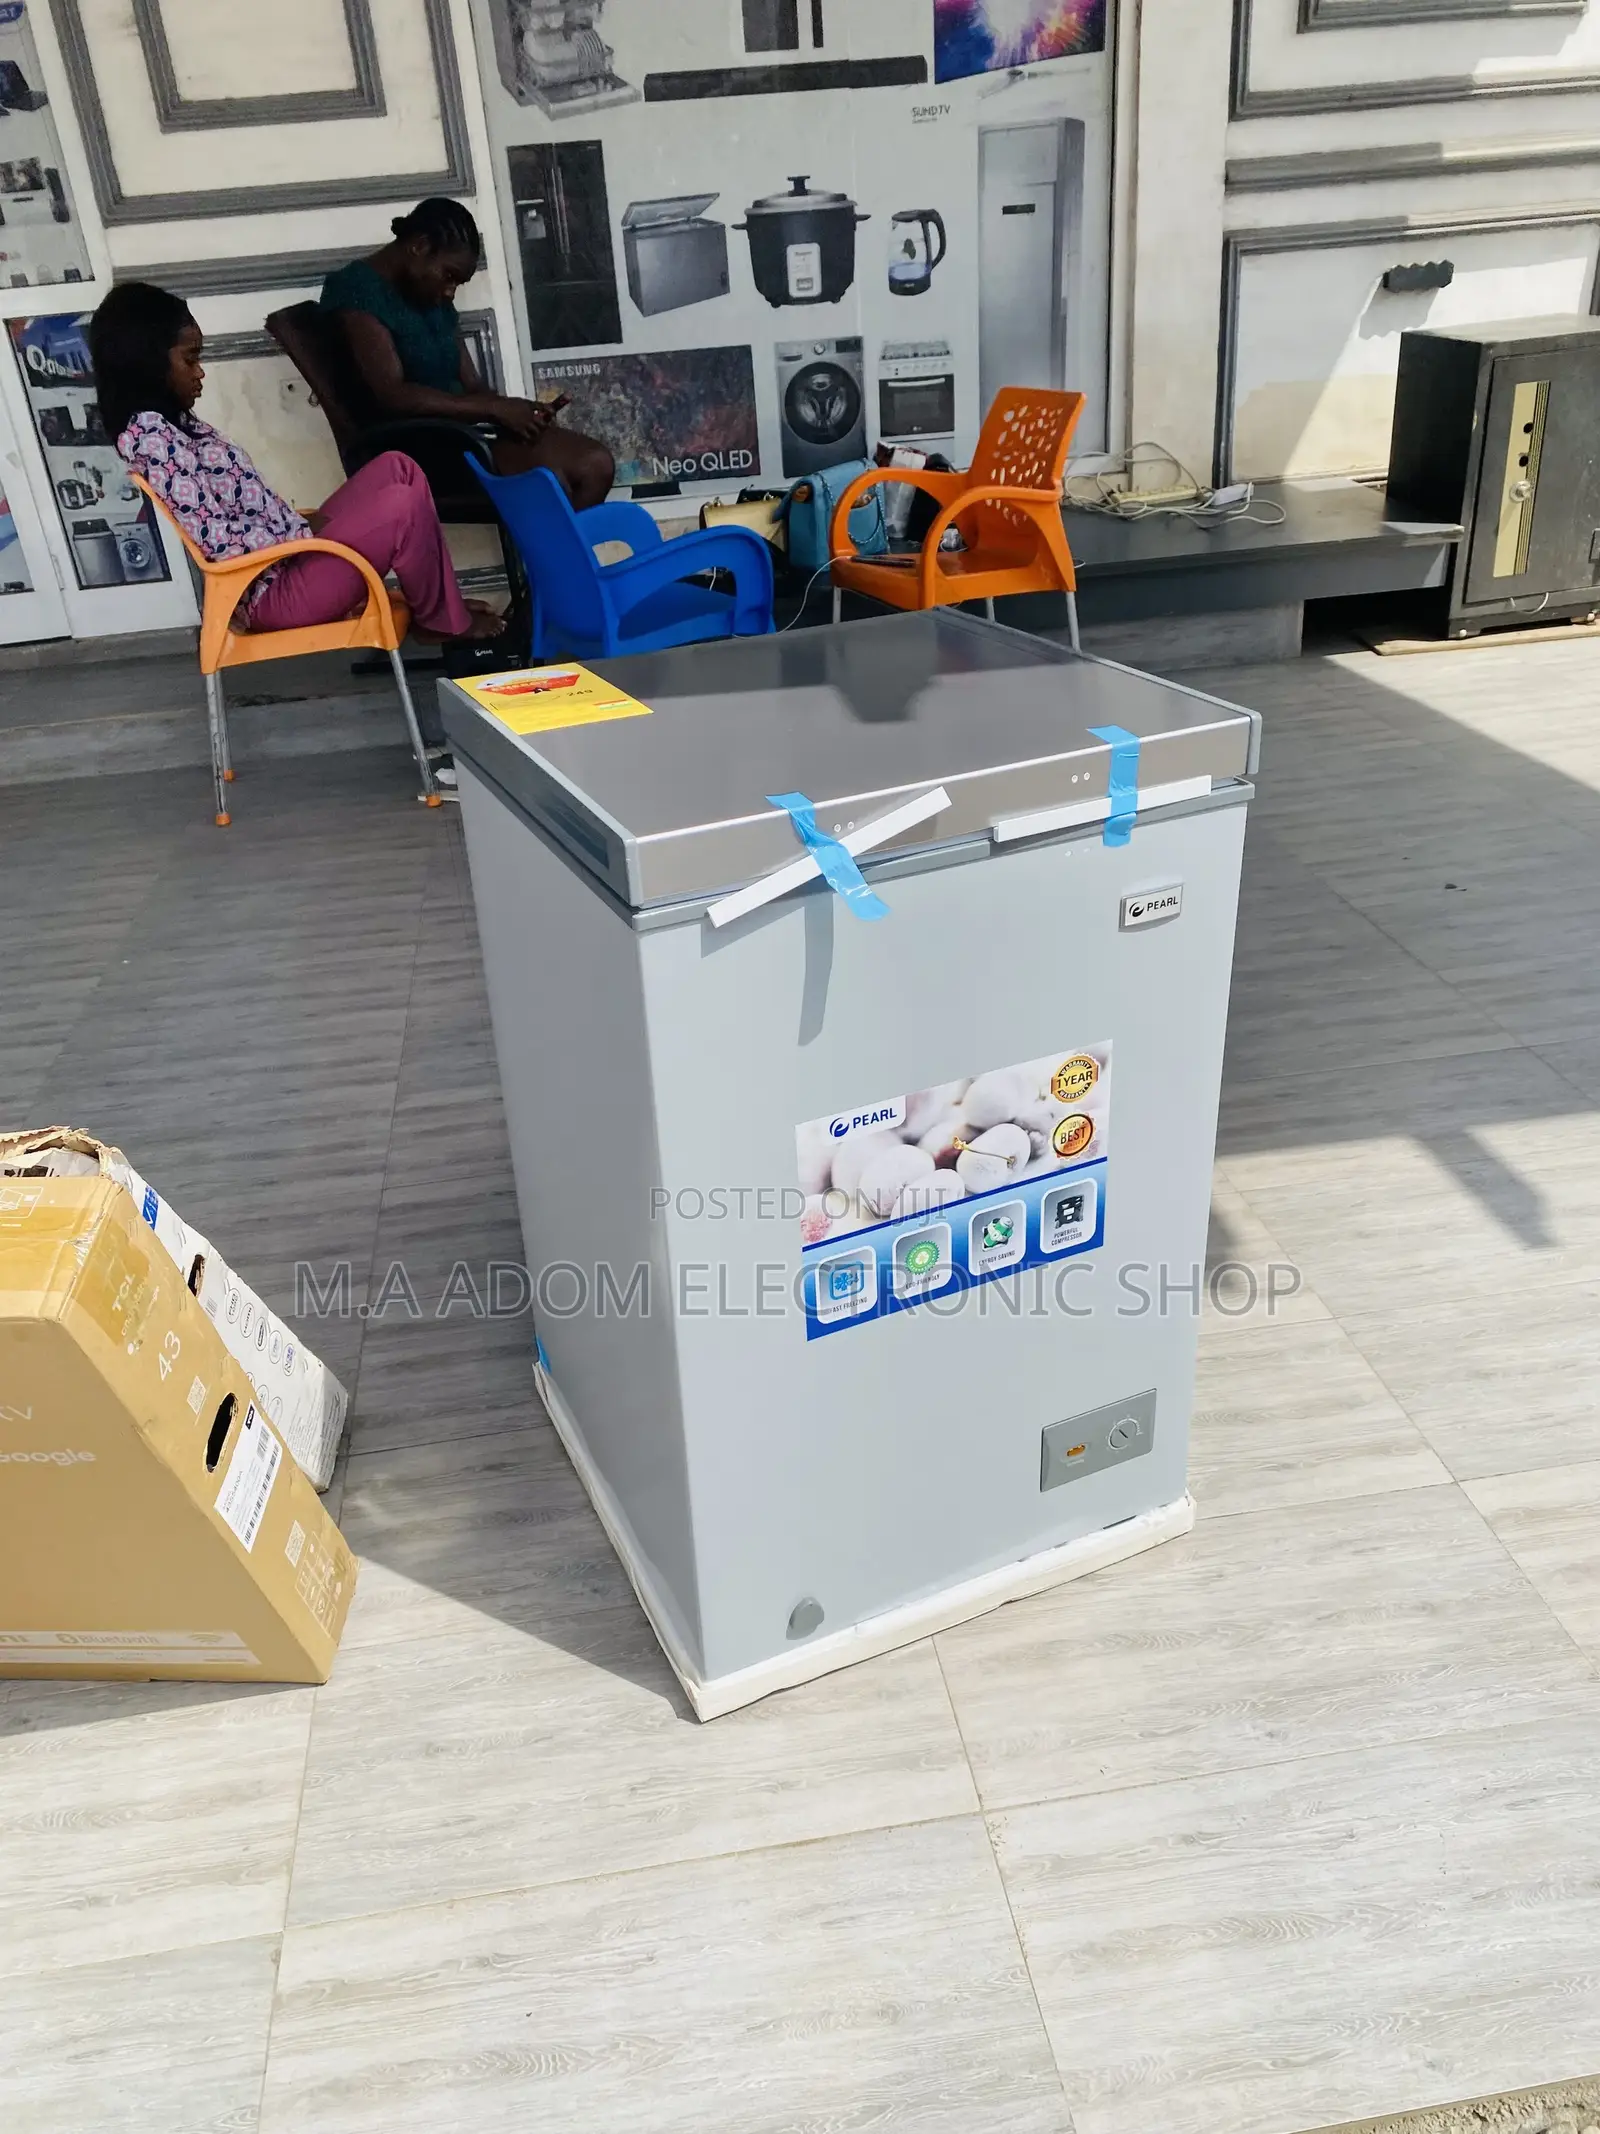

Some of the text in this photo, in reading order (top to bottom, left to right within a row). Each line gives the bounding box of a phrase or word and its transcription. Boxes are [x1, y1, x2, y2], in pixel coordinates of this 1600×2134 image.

[538, 363, 601, 380] SAMSUNG
[652, 449, 753, 476] Neo QLED
[1146, 896, 1179, 912] PEARL
[1063, 1070, 1093, 1087] YEAR
[852, 1107, 898, 1129] PEARL
[1060, 1126, 1087, 1145] BEST
[112, 1273, 136, 1311] TCL
[158, 1330, 181, 1381] 43
[79, 1634, 160, 1645] Bluetooth
